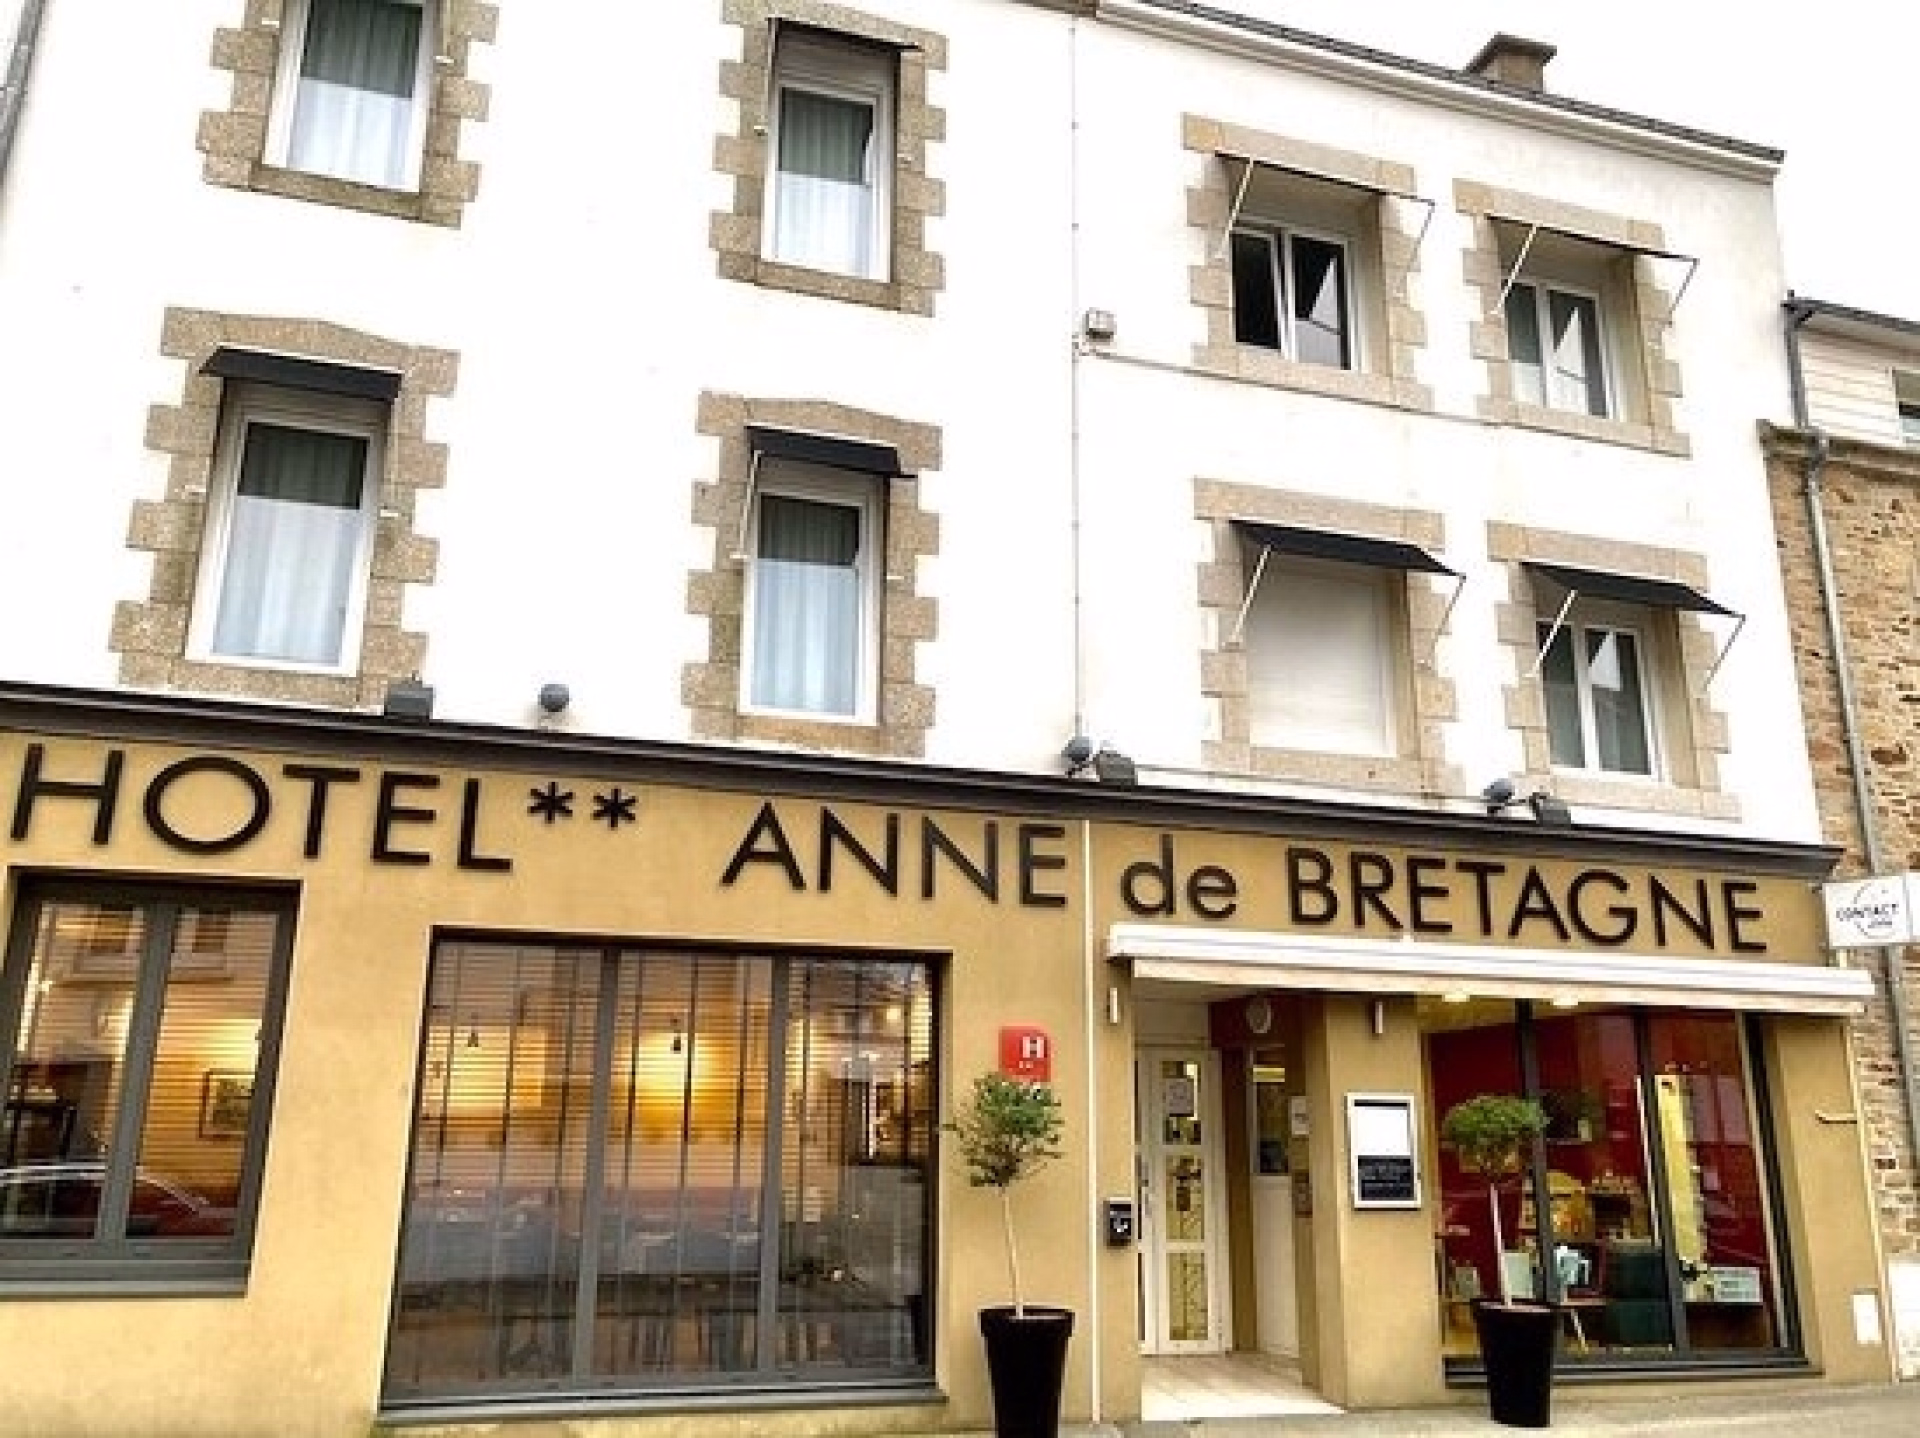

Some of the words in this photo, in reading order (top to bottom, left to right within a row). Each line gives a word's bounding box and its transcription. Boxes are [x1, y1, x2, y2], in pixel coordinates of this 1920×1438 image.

[721, 804, 1066, 908] ANNE
[1120, 834, 1238, 922] de
[1284, 844, 1767, 954] BRETAGNE
[1022, 1036, 1045, 1058] H
